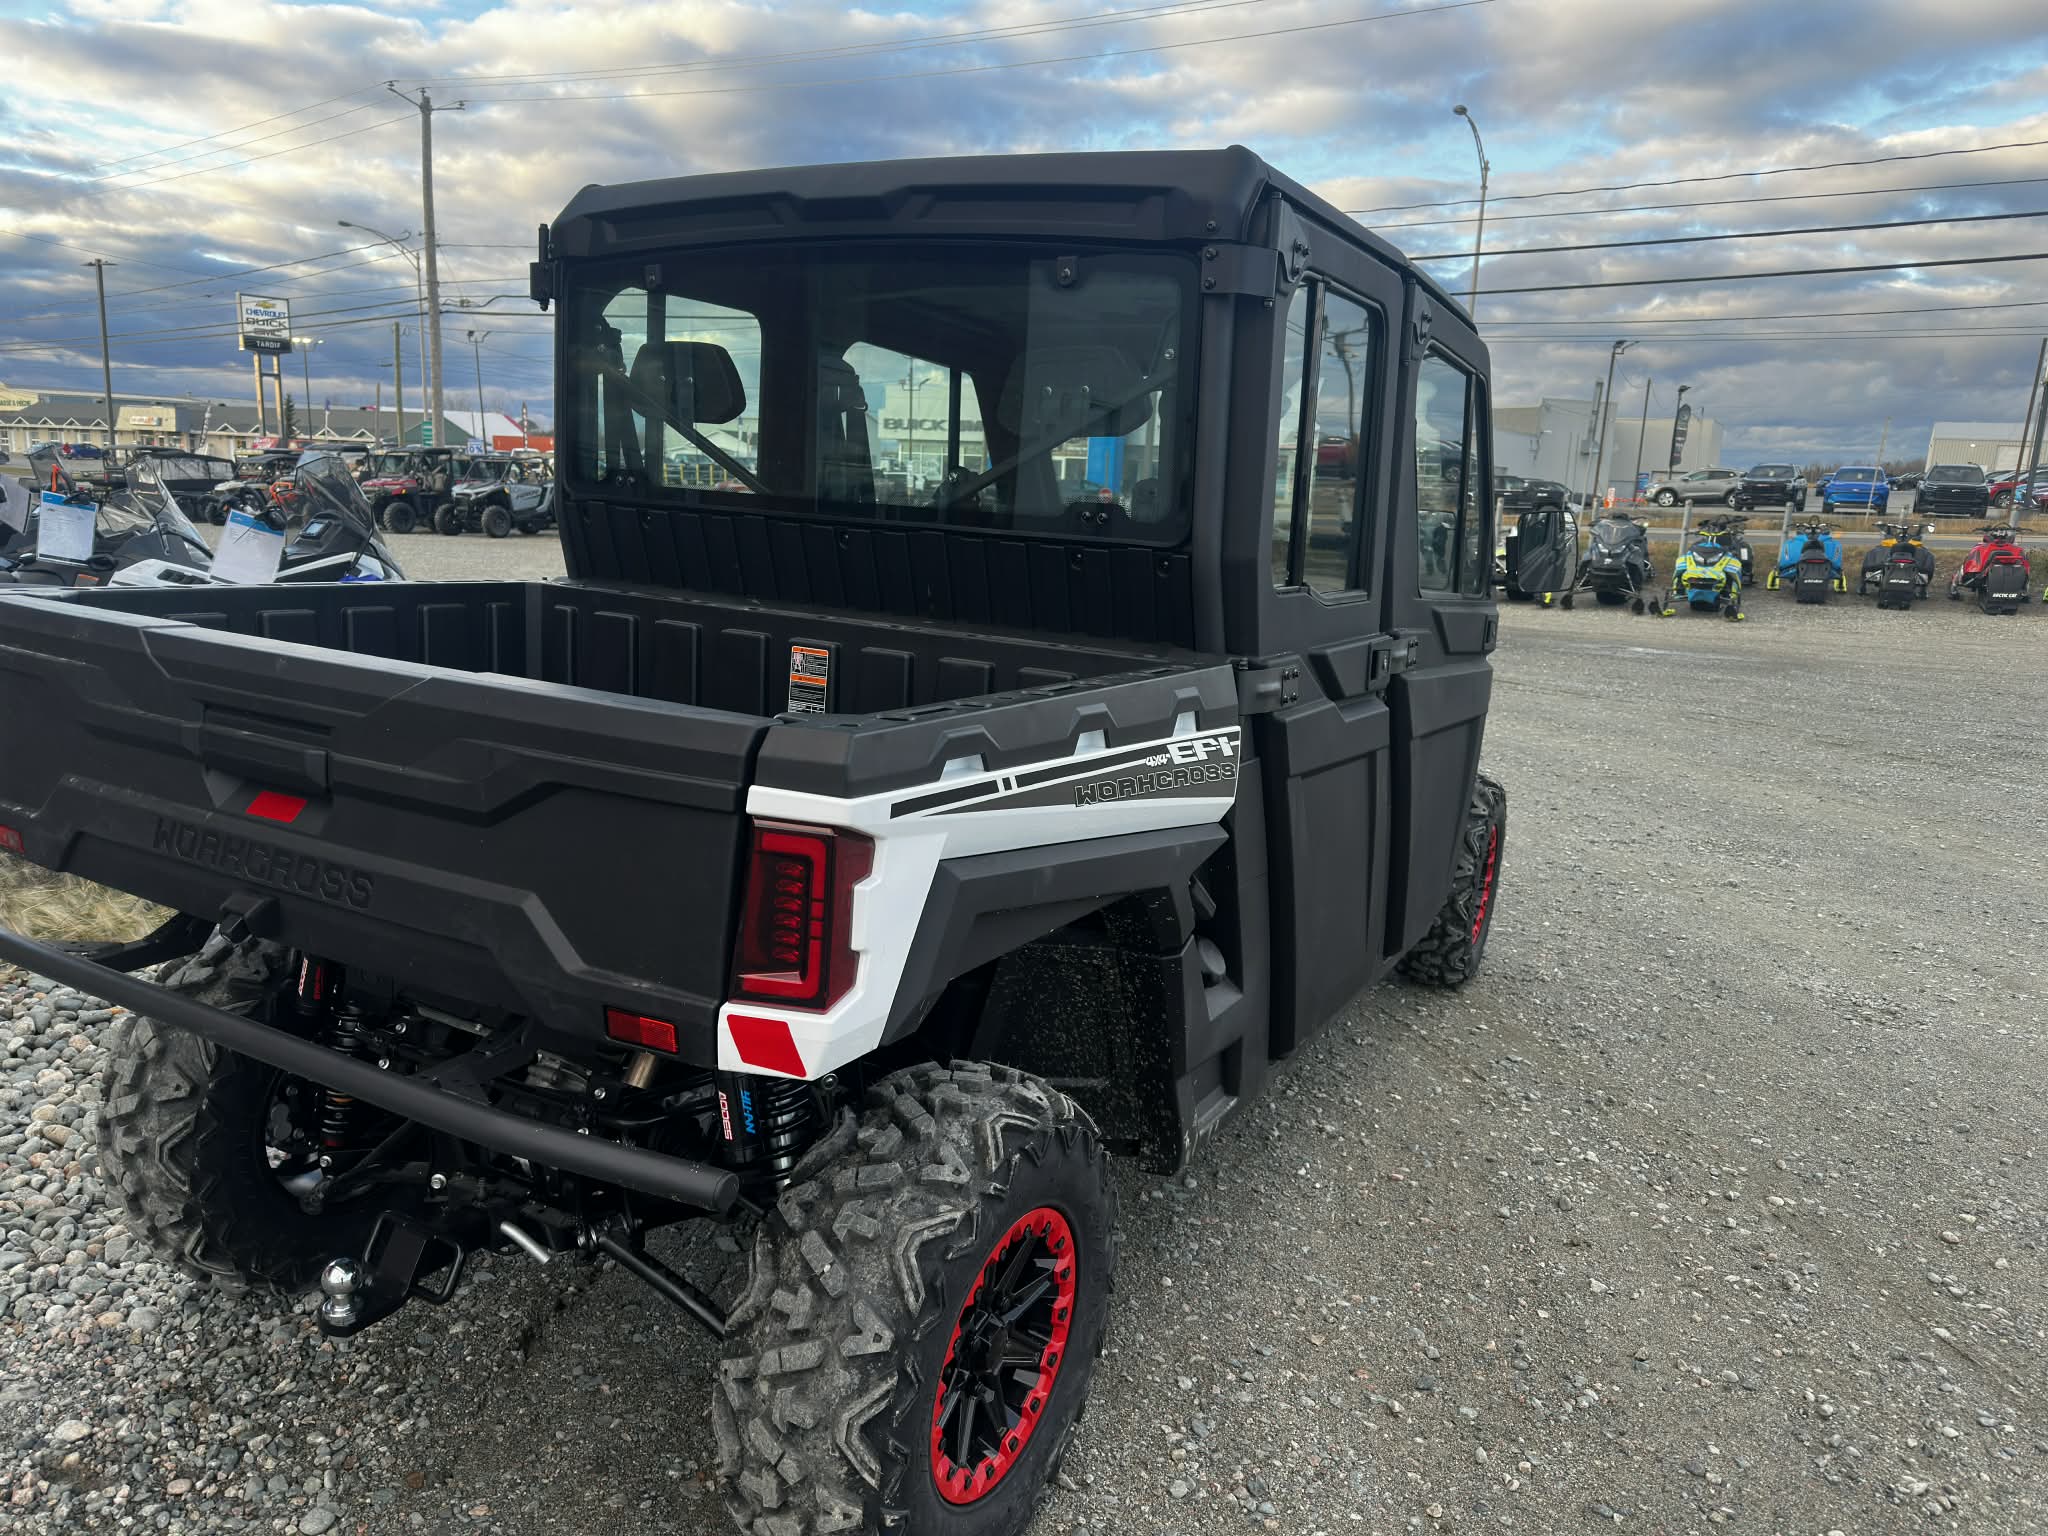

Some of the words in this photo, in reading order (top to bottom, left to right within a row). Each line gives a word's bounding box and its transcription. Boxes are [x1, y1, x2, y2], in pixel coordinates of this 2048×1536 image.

[246, 308, 287, 317] CHEVROLET
[246, 317, 287, 329] BUICK
[256, 340, 281, 349] TARDIF
[883, 418, 948, 431] BUICK
[1166, 736, 1234, 765] EFI
[718, 1090, 733, 1141] AODES
